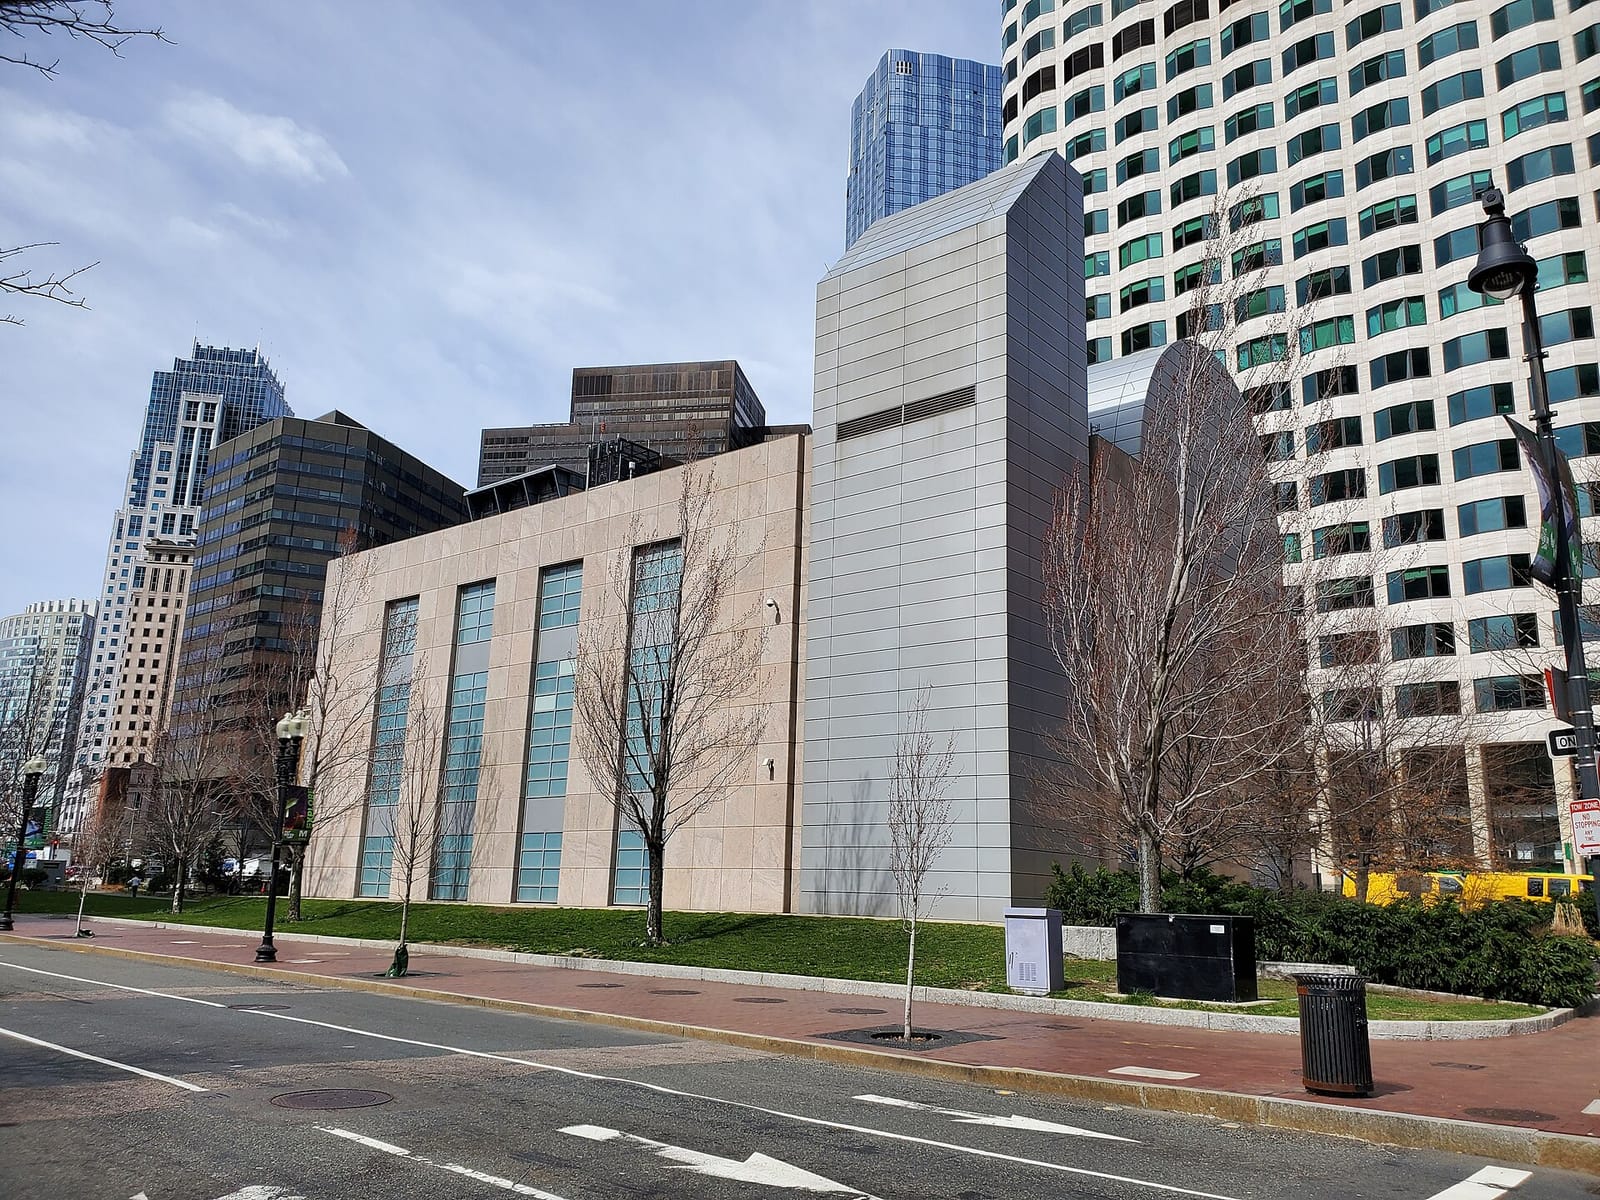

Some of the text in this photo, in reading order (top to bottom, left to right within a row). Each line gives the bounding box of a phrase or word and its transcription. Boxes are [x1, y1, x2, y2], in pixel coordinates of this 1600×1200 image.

[1560, 736, 1576, 747] ON
[306, 788, 314, 829] EXPLORE
[1571, 801, 1598, 811] TOW ZONE
